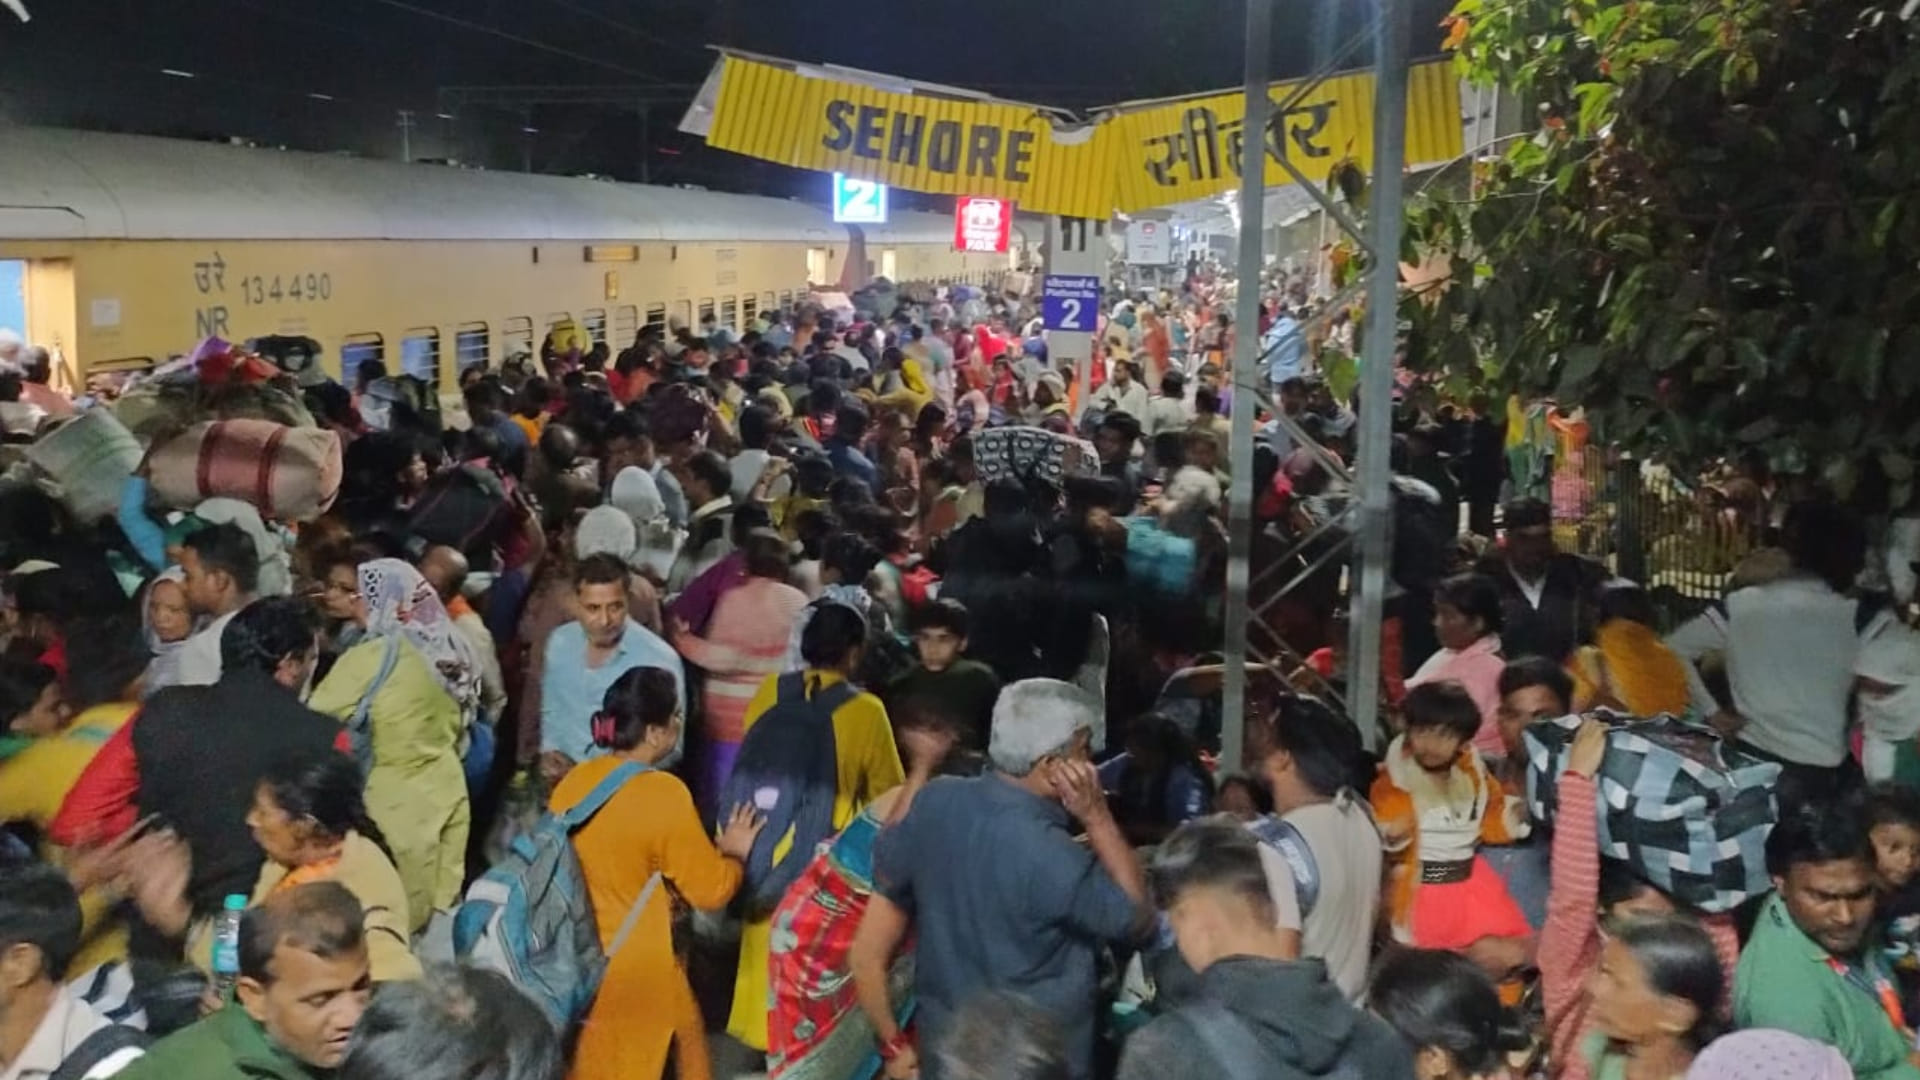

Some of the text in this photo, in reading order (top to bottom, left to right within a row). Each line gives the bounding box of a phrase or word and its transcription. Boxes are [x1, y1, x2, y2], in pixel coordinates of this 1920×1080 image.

[822, 100, 1035, 182] SEHORE
[841, 178, 878, 217] 2
[194, 251, 226, 294] उरे
[241, 272, 332, 305] 134490
[196, 306, 230, 338] NR
[1060, 299, 1081, 329] 2
